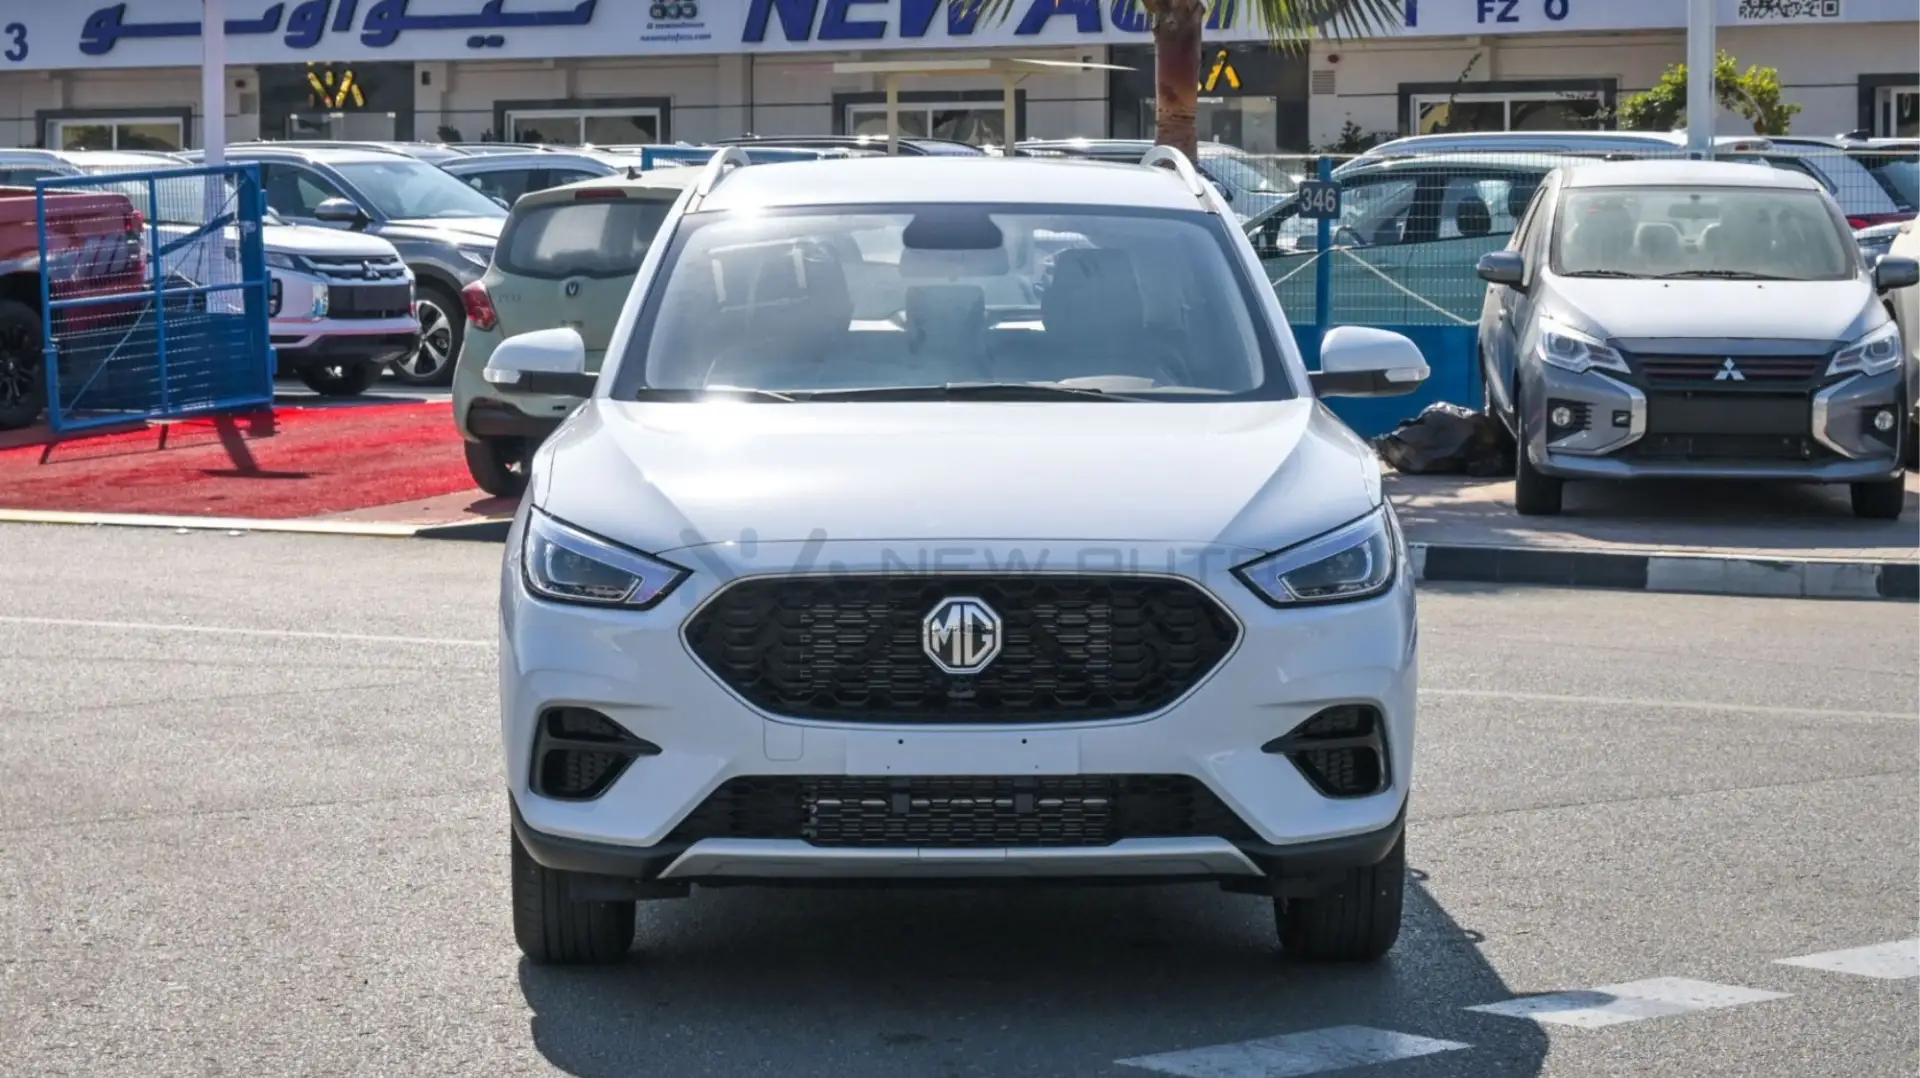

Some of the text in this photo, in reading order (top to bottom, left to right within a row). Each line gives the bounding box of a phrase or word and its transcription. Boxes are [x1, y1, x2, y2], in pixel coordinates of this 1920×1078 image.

[4, 22, 29, 62] 3
[1301, 187, 1336, 212] 346
[931, 604, 994, 666] MG
